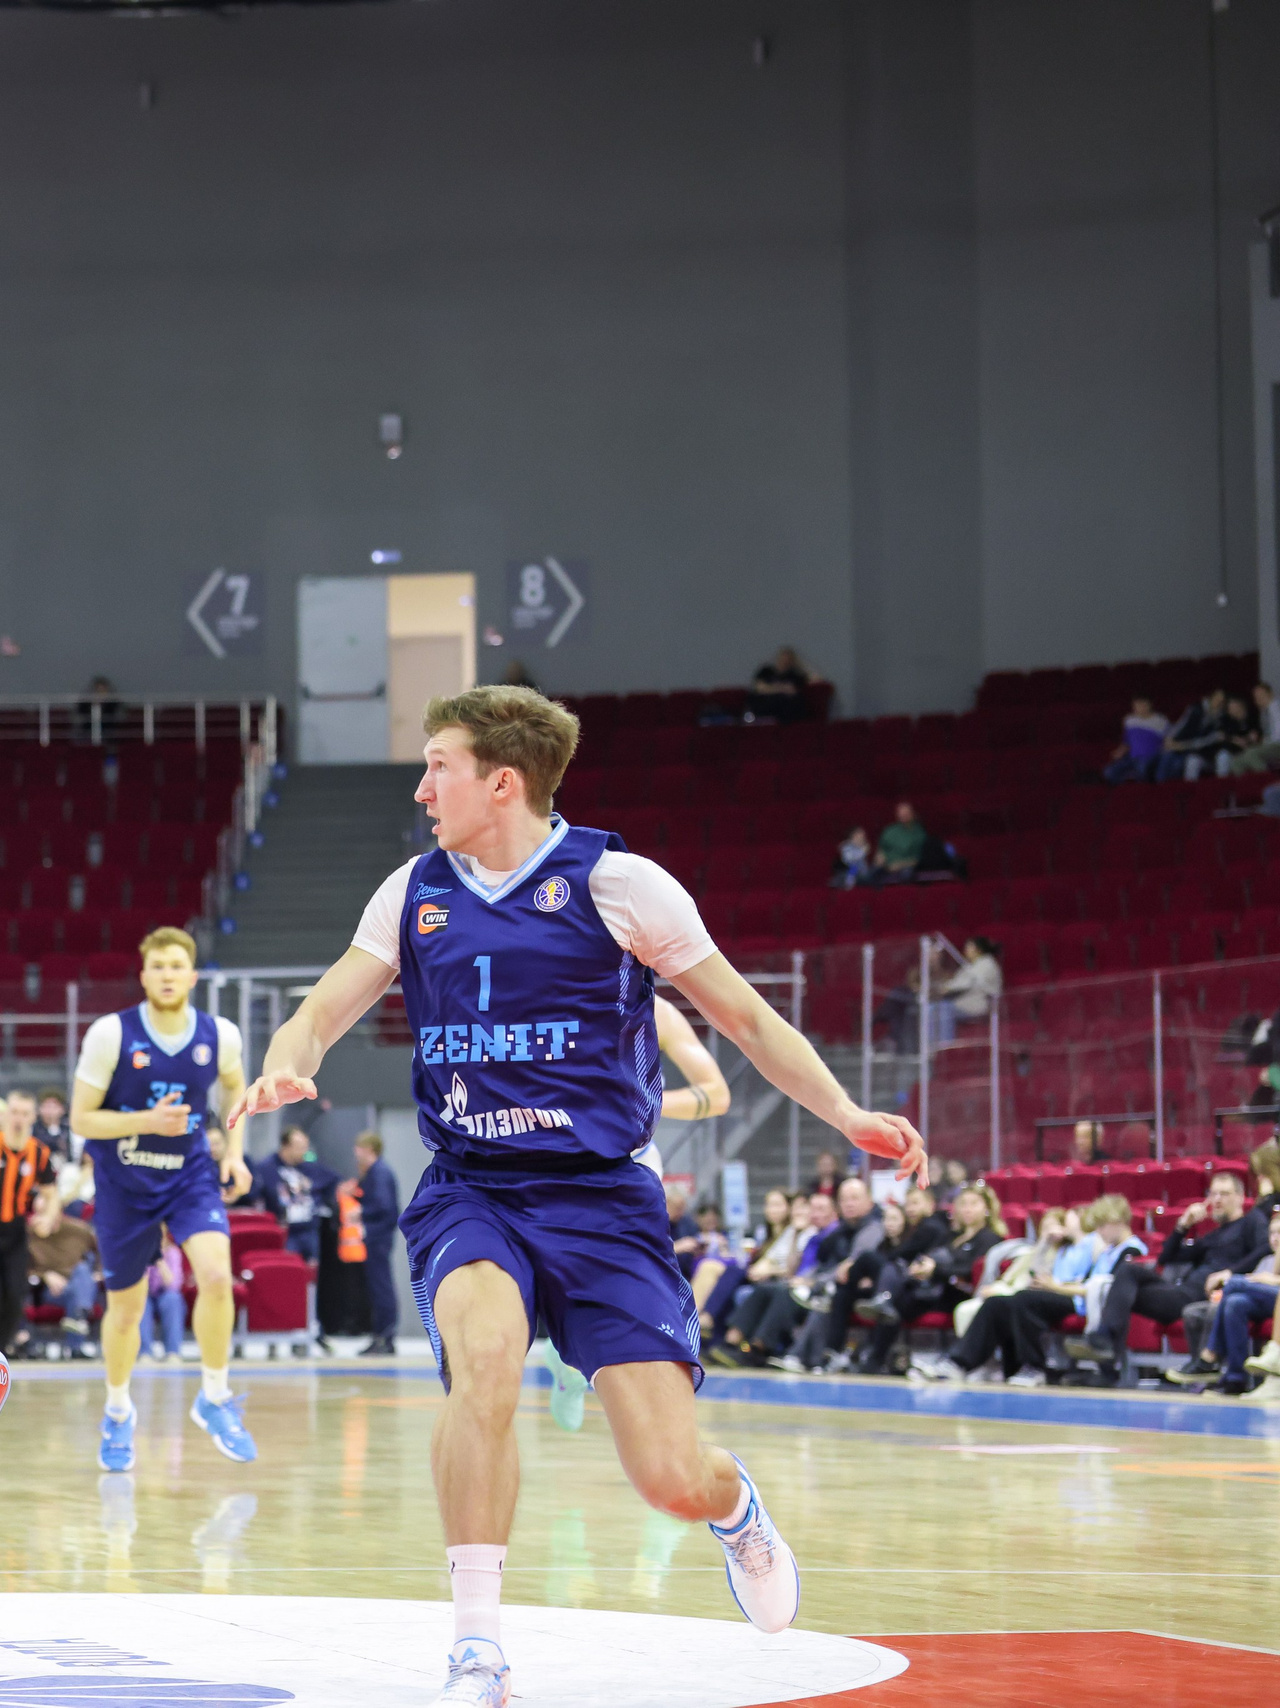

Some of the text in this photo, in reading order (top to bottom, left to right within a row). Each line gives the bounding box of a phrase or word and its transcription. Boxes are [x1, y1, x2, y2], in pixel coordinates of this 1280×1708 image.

[225, 575, 250, 615] 7
[521, 564, 545, 605] 8
[425, 913, 448, 924] WIN
[473, 955, 491, 1012] 1
[420, 1020, 580, 1065] ZENIT
[474, 1107, 574, 1139] ГАЗПРОМ
